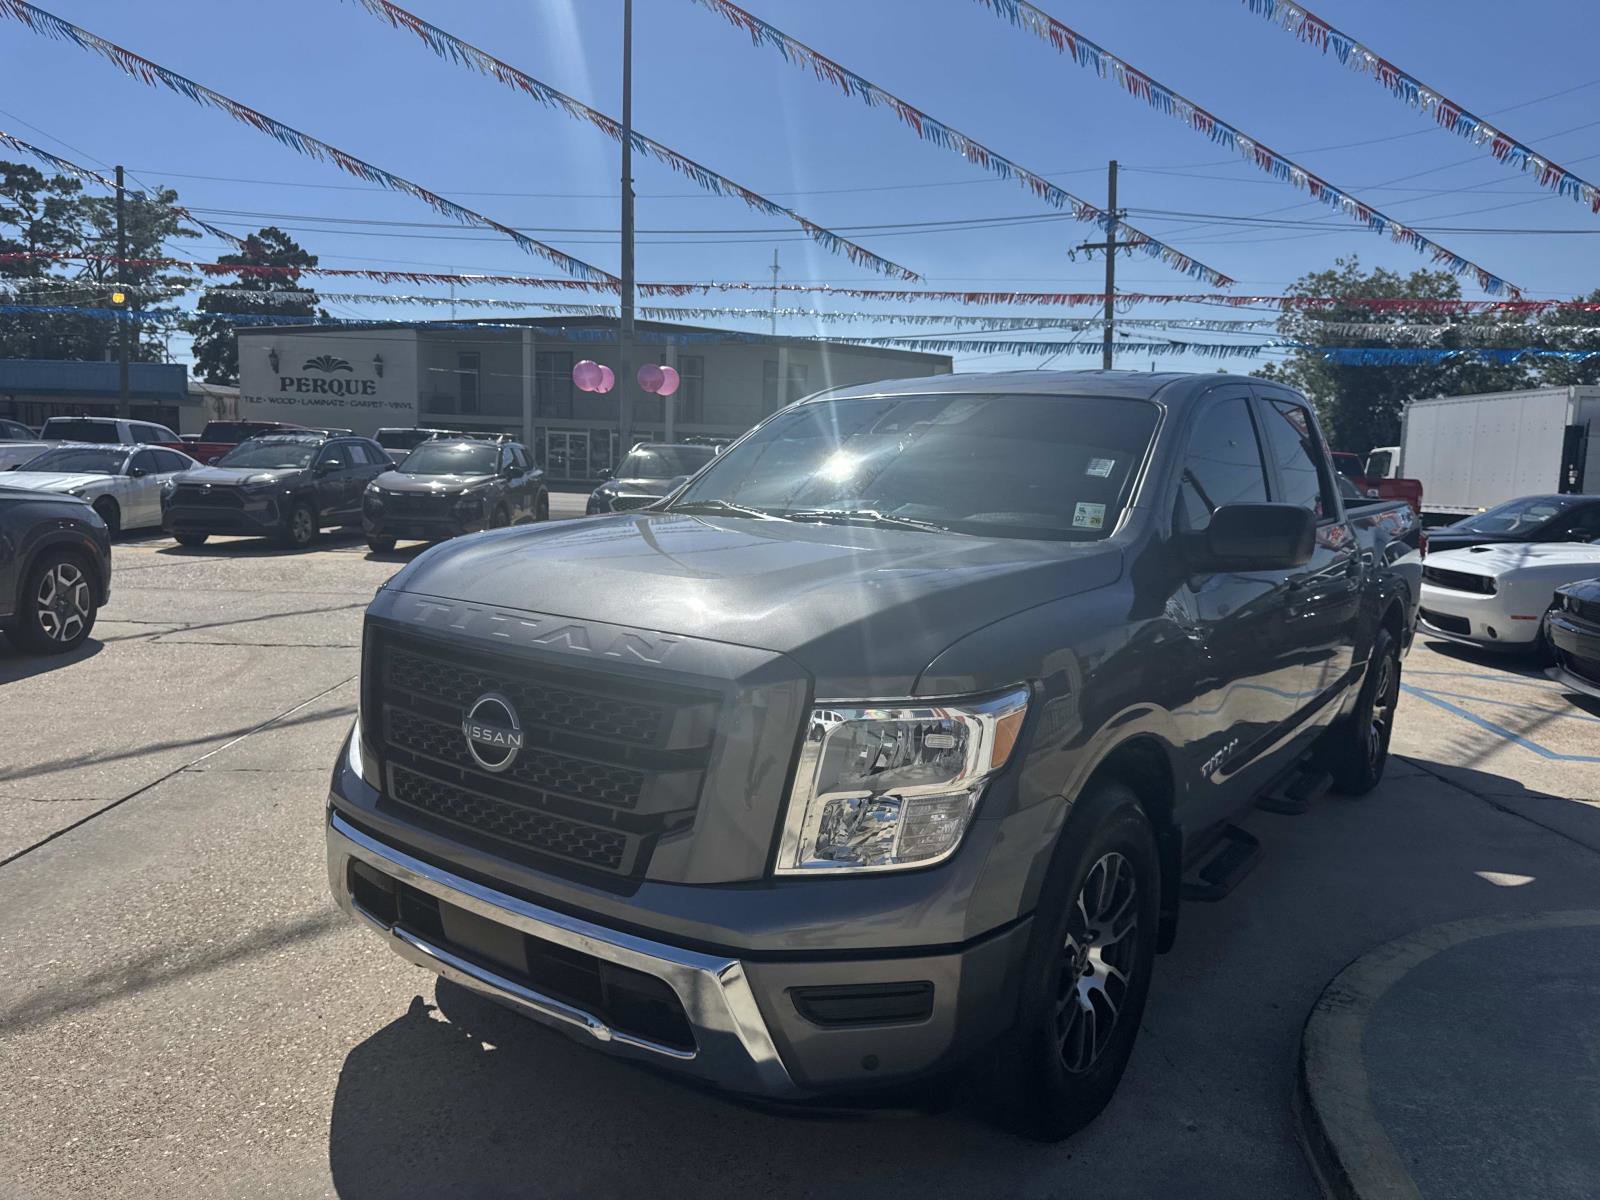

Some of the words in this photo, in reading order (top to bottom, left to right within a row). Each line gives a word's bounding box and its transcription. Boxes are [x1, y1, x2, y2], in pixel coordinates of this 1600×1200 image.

[280, 376, 377, 397] PERQUE
[244, 395, 263, 404] TILE
[268, 396, 297, 405] WOOD
[301, 398, 345, 407] LAMINATE
[350, 400, 384, 408] CARPET
[389, 401, 414, 410] VINYL
[415, 599, 679, 664] TITAN
[462, 721, 522, 746] NISSAN
